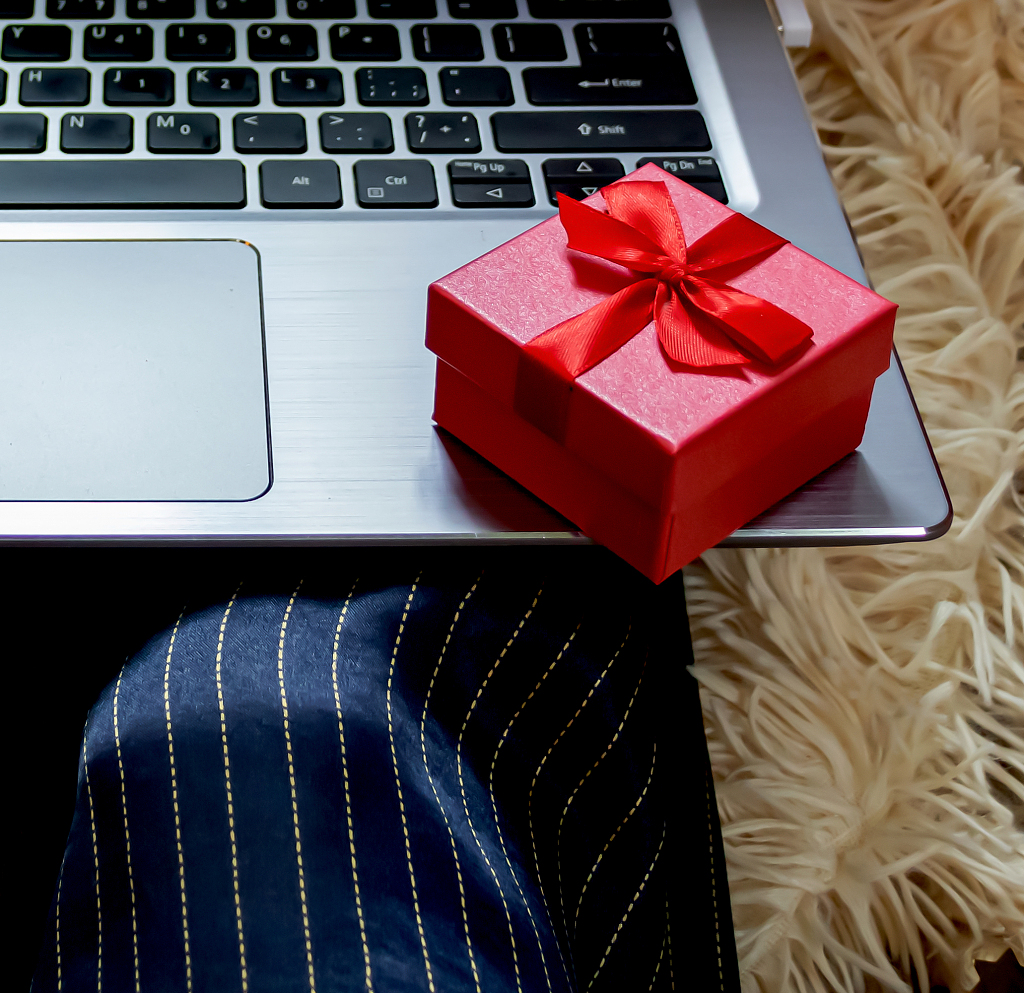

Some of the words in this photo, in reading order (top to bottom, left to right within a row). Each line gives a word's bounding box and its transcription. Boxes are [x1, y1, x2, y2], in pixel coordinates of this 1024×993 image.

[57, 0, 67, 11] 7
[11, 26, 24, 39] Y
[91, 26, 106, 39] U
[256, 25, 272, 39] O
[338, 25, 351, 38] P
[28, 70, 43, 83] H
[113, 70, 122, 83] J
[196, 70, 210, 83] K
[281, 70, 291, 83] L
[612, 78, 643, 88] Enter
[139, 78, 146, 89] 1
[220, 78, 231, 90] 2
[306, 78, 316, 90] 3
[70, 115, 84, 128] N
[156, 115, 175, 128] M
[597, 124, 626, 135] Shift
[473, 162, 487, 173] Pg
[489, 163, 505, 173] Up
[663, 161, 678, 173] Pg
[679, 160, 694, 170] Dn
[292, 175, 310, 185] Alt
[385, 175, 407, 185] Ctrl
